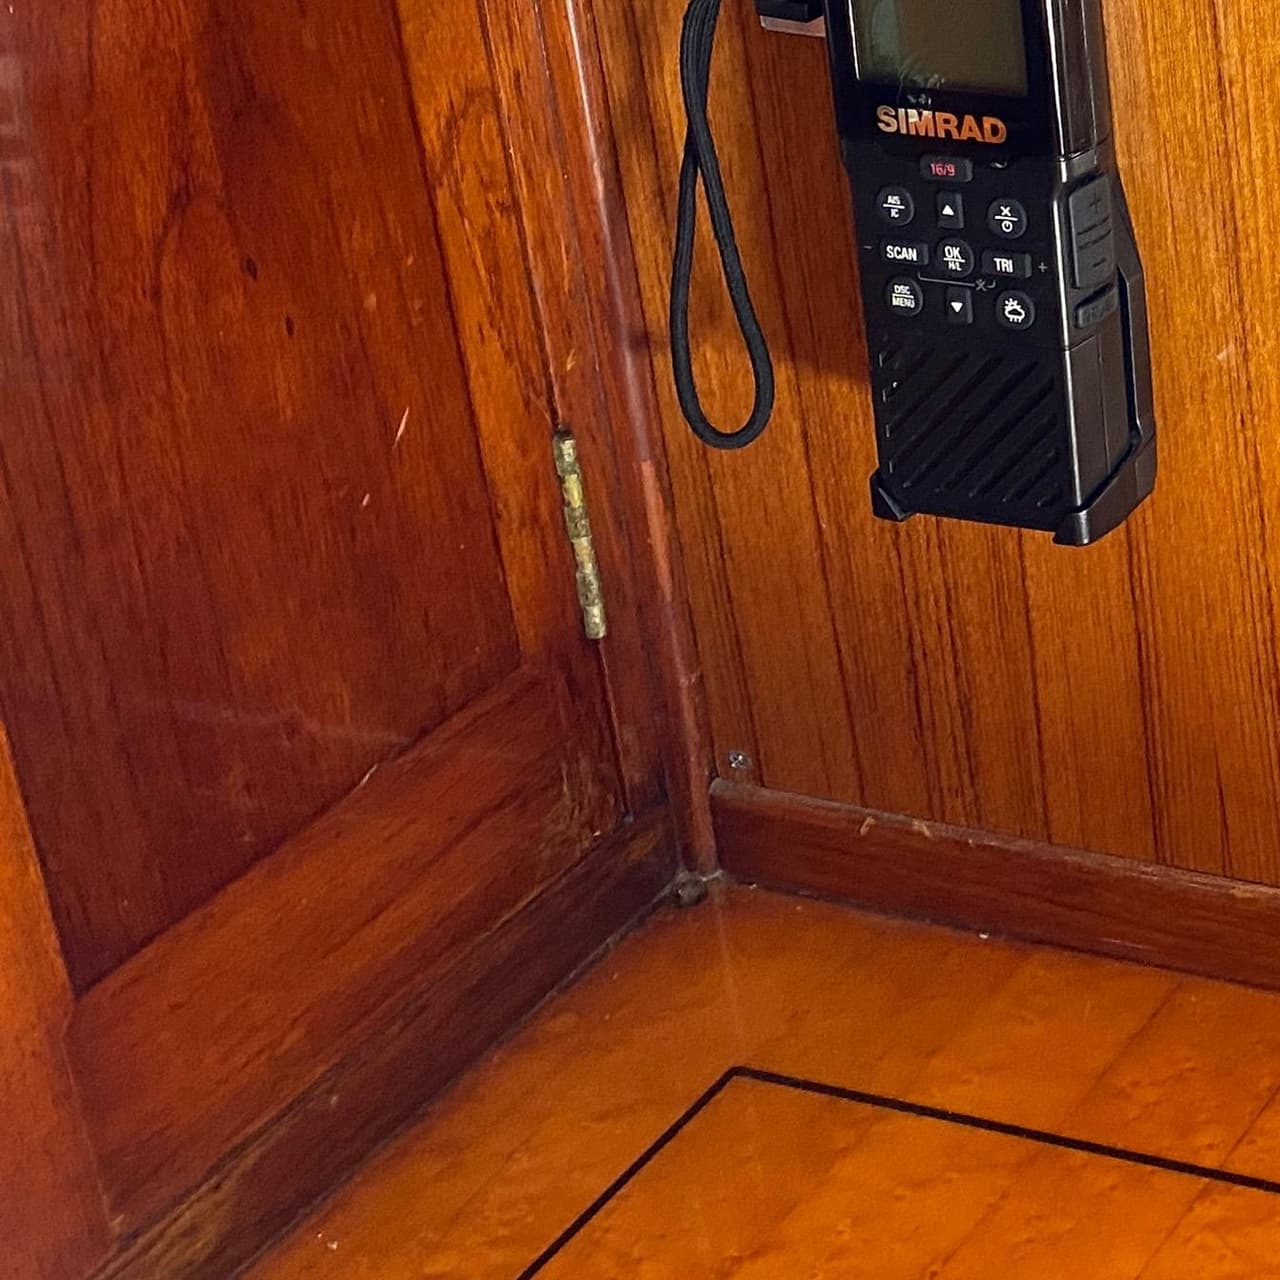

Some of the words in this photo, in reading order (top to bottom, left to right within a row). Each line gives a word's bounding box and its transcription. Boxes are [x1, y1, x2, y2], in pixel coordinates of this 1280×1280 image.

[876, 105, 1007, 144] SIMRAD
[930, 163, 955, 176] 16/9
[886, 245, 918, 261] SCAN
[944, 245, 961, 259] OK
[993, 258, 1013, 273] TRI
[893, 284, 911, 295] DSC
[892, 297, 915, 308] MENU
